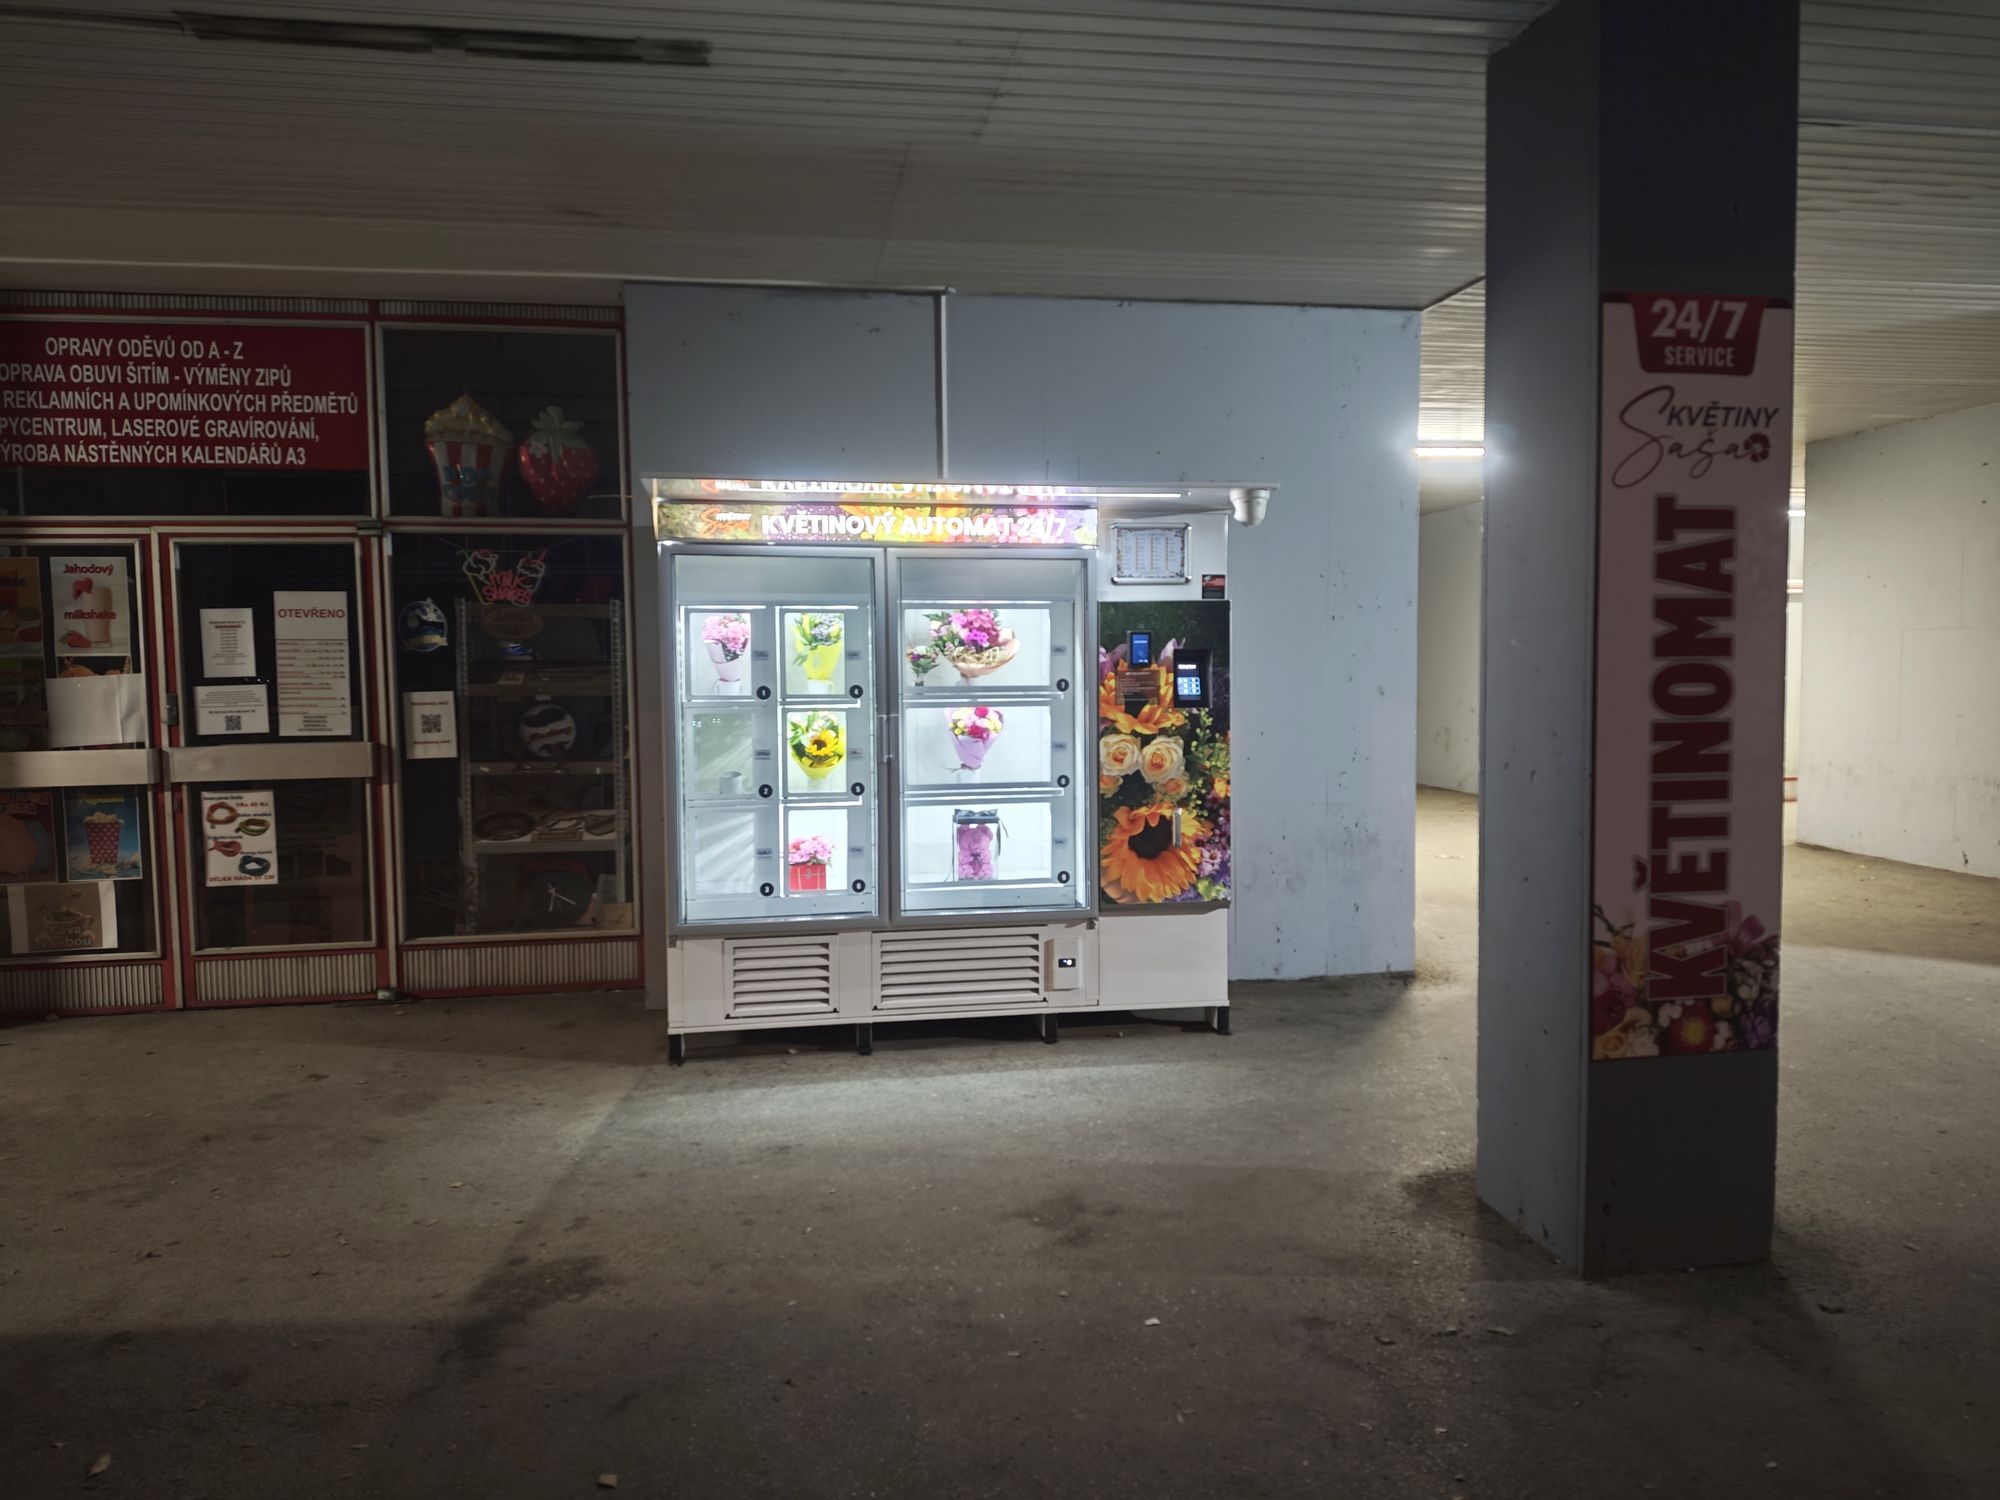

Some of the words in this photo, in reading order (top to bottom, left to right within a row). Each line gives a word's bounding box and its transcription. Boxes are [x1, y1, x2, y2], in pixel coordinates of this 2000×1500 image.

[1650, 298, 1748, 343] 24/7
[45, 337, 114, 357] OPRAVY
[118, 335, 176, 359] ODĚVŮ
[180, 340, 205, 359] OD
[208, 340, 221, 359] A
[233, 341, 244, 359] Z
[1664, 346, 1735, 368] SERVICE
[0, 363, 67, 383] OPRAVA
[69, 364, 122, 383] OBUVI
[126, 361, 170, 384] ŠITÍM
[183, 362, 252, 386] VÝMĚNY
[255, 364, 292, 387] ZIPŮ
[3, 387, 114, 410] REKLAMNÍCH
[118, 392, 131, 410] A
[134, 388, 267, 412] UPOMÍNKOVÝCH
[271, 390, 358, 414] PŘEDMĚTŮ
[1667, 401, 1780, 428] KVĚTINY
[111, 415, 200, 438] LASEROVÉ
[204, 416, 320, 442] GRAVÍROVÁNÍ,
[64, 440, 177, 464] NÁSTĚNNÝCH
[181, 442, 282, 464] KALENDÁŘŮ
[285, 447, 306, 465] A3
[761, 510, 896, 535] KVĚTINOVÝ
[901, 516, 1014, 536] AUTOMAT
[1016, 514, 1066, 541] 24/7
[62, 563, 114, 576] Jahodový
[63, 609, 117, 621] milkshake
[277, 607, 346, 619] OTEVŘENO
[1633, 495, 1738, 1000] KVĚTINOMAT
